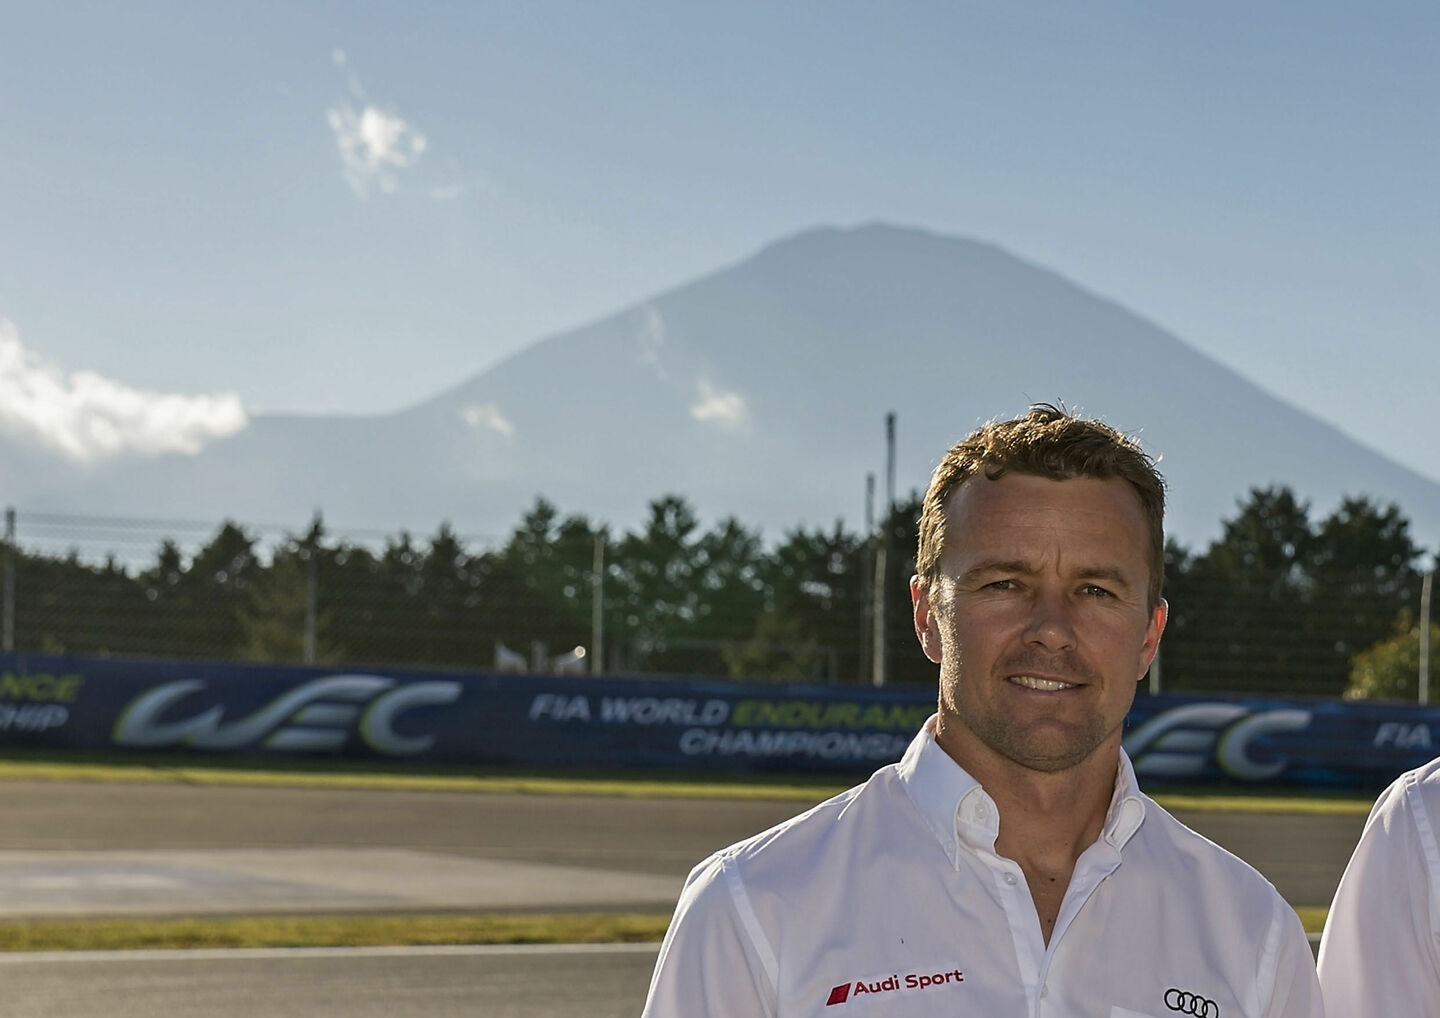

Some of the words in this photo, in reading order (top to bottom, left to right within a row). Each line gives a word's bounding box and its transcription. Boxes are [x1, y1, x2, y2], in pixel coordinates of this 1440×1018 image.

[112, 673, 463, 756] WEC
[528, 692, 592, 722] FIA
[601, 696, 731, 725] WORLD
[1373, 722, 1432, 748] FIA
[853, 974, 900, 997] Audi
[904, 969, 964, 990] Sport
